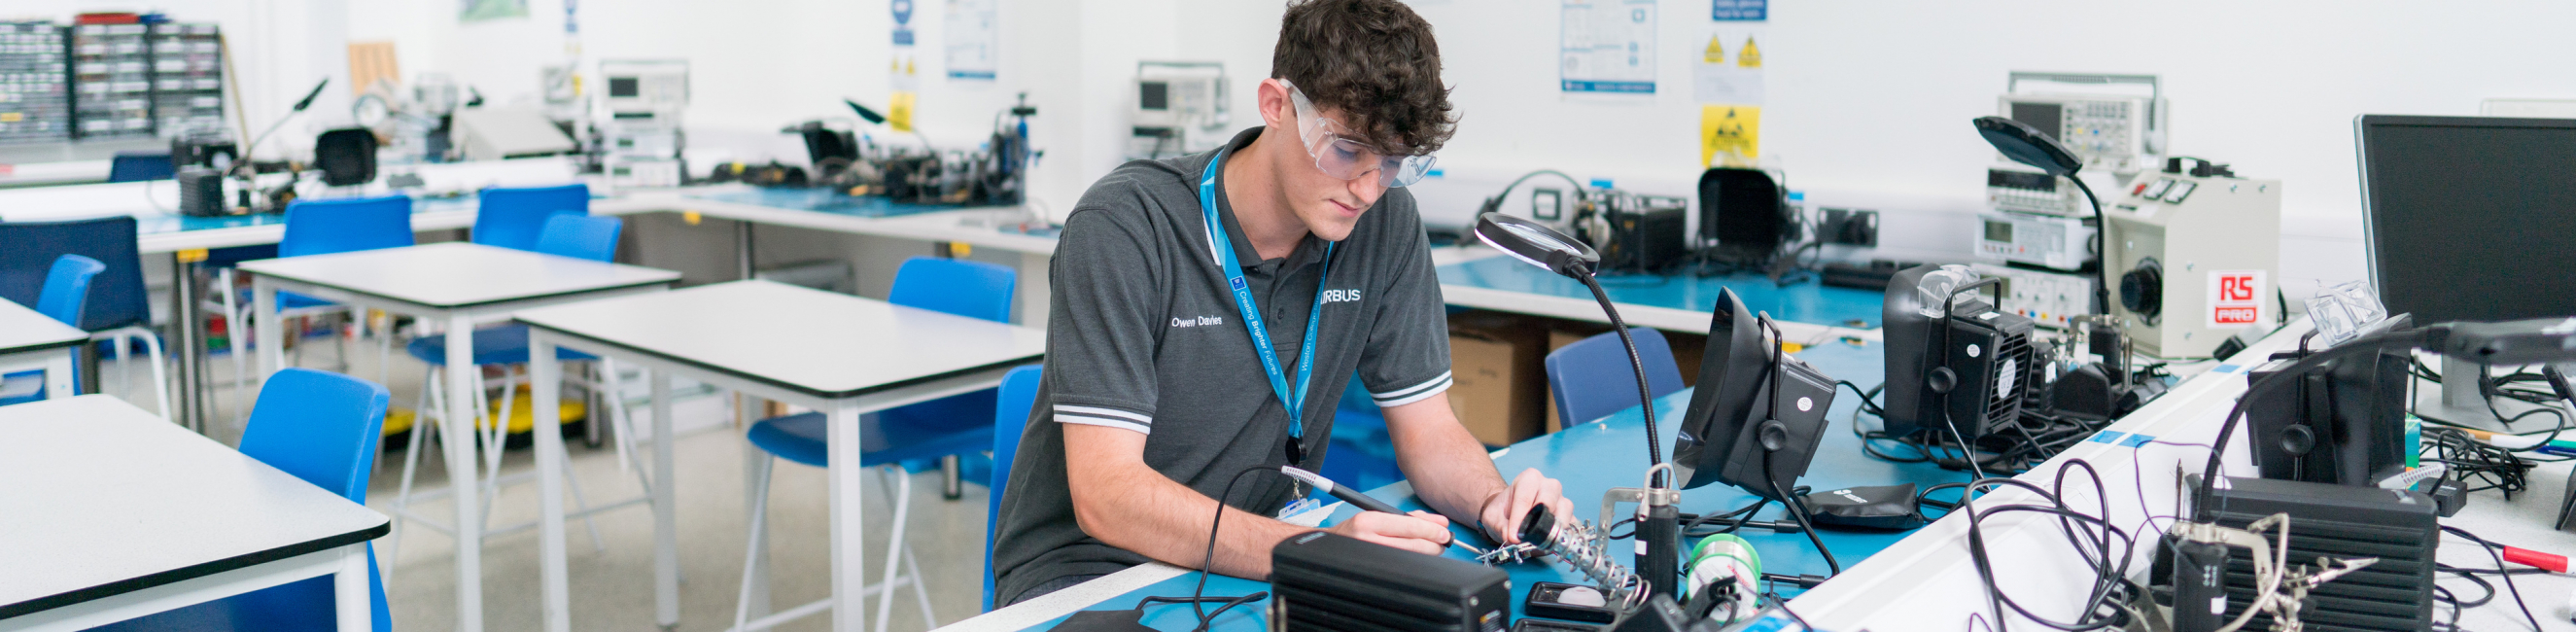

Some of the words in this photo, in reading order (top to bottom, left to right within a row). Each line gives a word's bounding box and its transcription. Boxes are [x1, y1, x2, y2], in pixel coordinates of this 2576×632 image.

[2220, 276, 2253, 301] RS
[1171, 317, 1196, 328] Owen
[1198, 314, 1223, 326] Davies
[2216, 309, 2255, 323] PRO
[1239, 291, 1255, 320] Creating
[1251, 320, 1268, 350] Brighter
[1264, 350, 1278, 376] Futures
[1301, 342, 1312, 371] Weston
